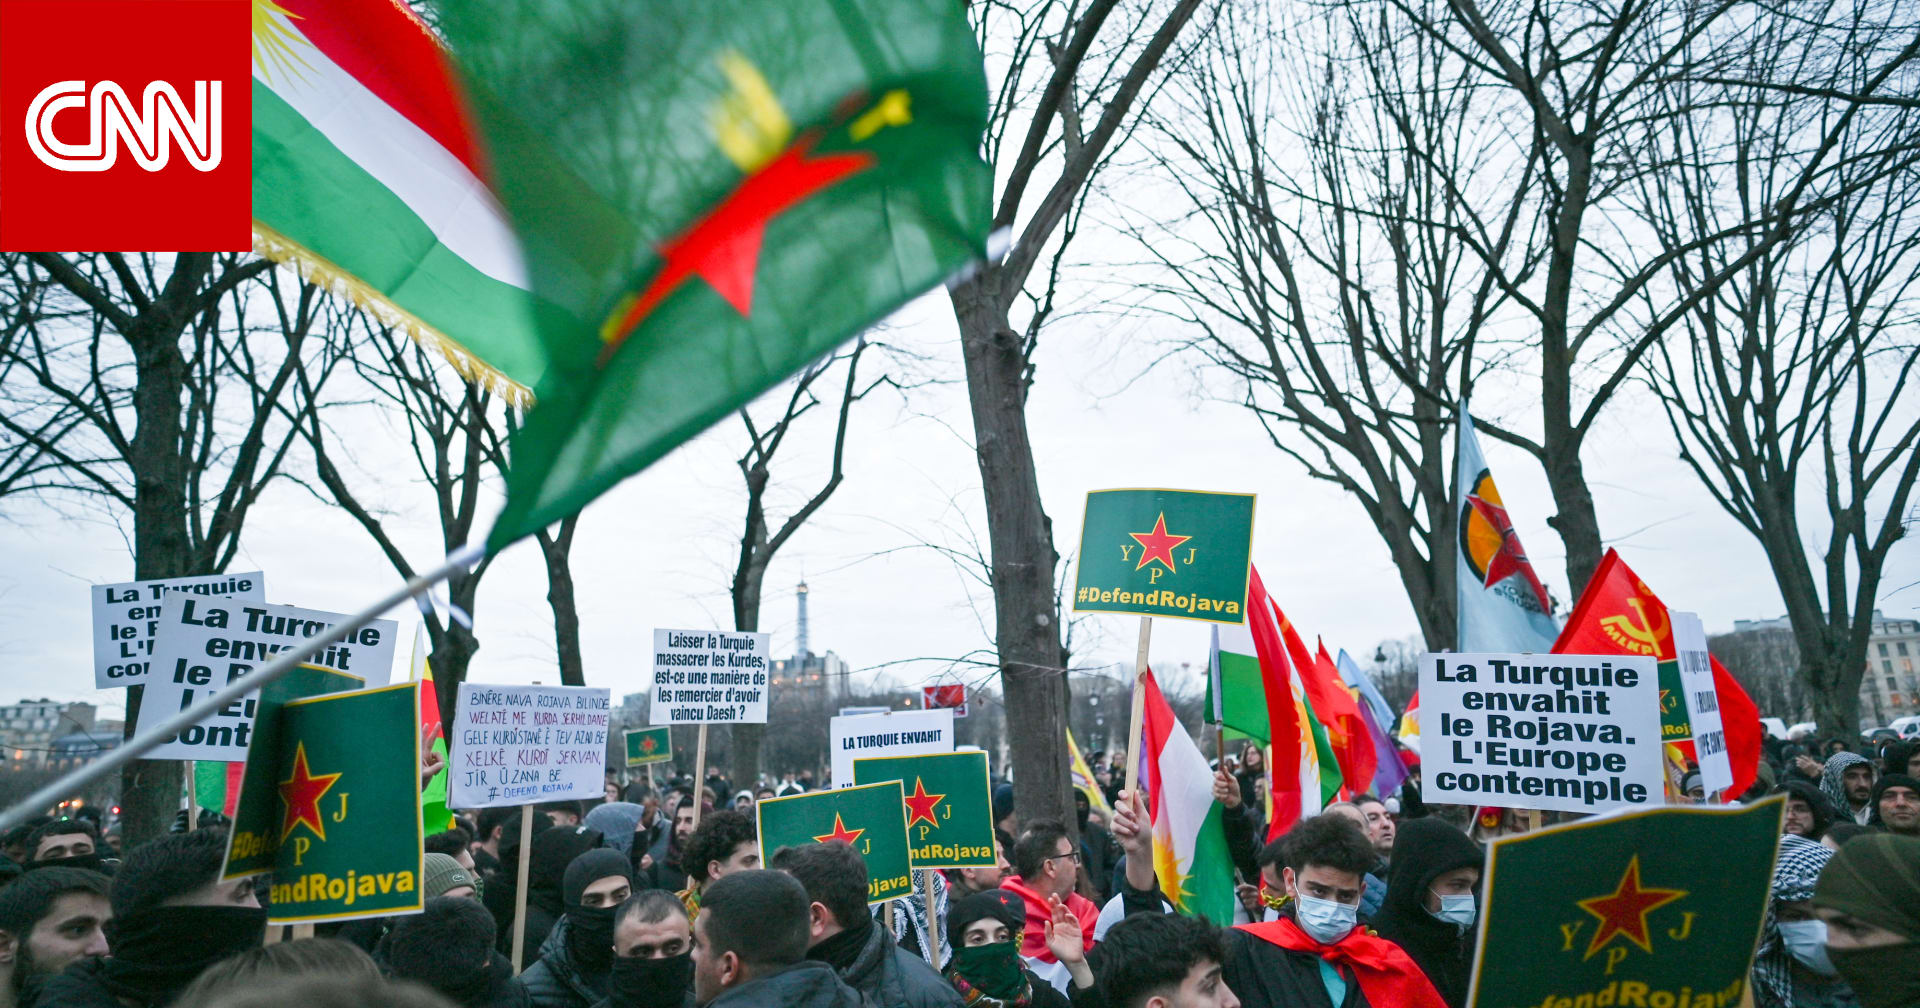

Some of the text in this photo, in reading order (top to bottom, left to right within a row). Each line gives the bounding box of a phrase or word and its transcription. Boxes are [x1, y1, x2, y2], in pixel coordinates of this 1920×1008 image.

[1120, 545, 1197, 584] Y P J
[106, 588, 140, 604] La
[1078, 587, 1240, 614] #DefendRojava
[181, 599, 229, 629] La
[111, 625, 137, 641] le
[668, 632, 755, 653] Laisser la Turquie
[1603, 624, 1653, 655] MLKP
[656, 651, 766, 671] massacrer les Kurdes,
[173, 658, 212, 686] le
[655, 669, 766, 686] est-ce une manière de
[1436, 659, 1639, 691] La Turquie
[506, 694, 532, 707] NAVA
[537, 695, 571, 709] ROJAVA
[658, 686, 761, 703] les remercier d'avoir
[1462, 689, 1611, 715] envahit
[1669, 696, 1677, 708] J
[512, 712, 527, 725] ME
[534, 712, 558, 726] KURDA
[671, 705, 746, 720] vaincu Daesh ?
[464, 729, 488, 745] GELE
[555, 729, 573, 745] TEV
[594, 730, 605, 745] BE
[843, 729, 942, 750] LA TURQUIE ENVAHIT
[1441, 713, 1474, 737] le
[1487, 714, 1636, 746] Rojava.
[1452, 740, 1627, 776] L'Europe
[511, 768, 540, 784] ZANA
[549, 769, 561, 783] BE
[503, 787, 538, 798] DEFEND
[1436, 771, 1648, 805] contemple
[293, 793, 349, 866] P J
[919, 804, 952, 841] P J
[862, 839, 871, 855] J
[911, 844, 992, 862] ndRojava
[270, 869, 414, 905] endRojava
[1559, 912, 1697, 975] Y P J
